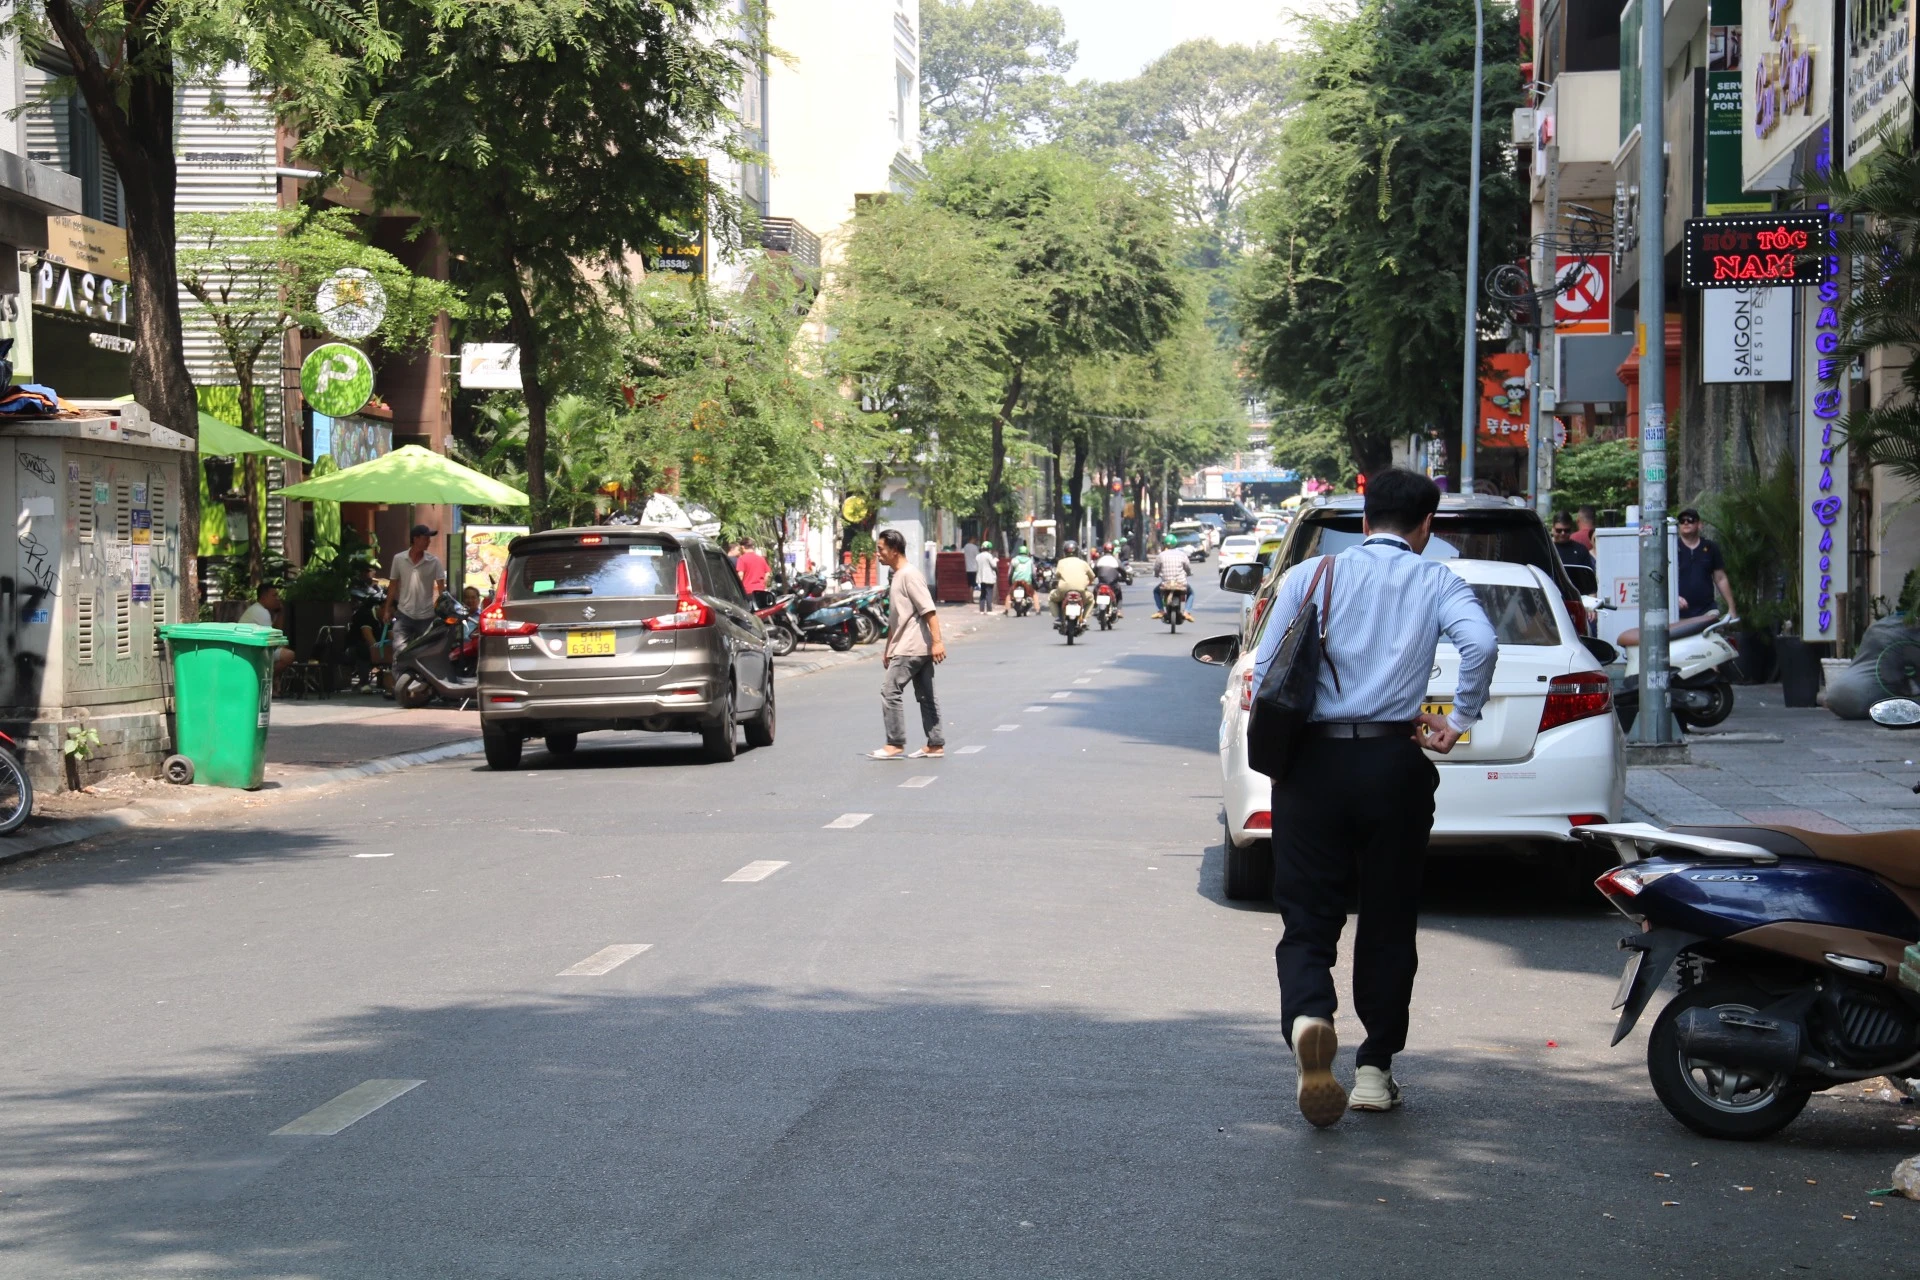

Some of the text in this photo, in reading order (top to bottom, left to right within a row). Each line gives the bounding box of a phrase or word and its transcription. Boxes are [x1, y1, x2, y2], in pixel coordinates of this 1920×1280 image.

[1713, 102, 1735, 111] FOR
[1703, 226, 1808, 250] HỚT TÓC
[654, 259, 692, 270] assag
[1713, 254, 1795, 279] NAM
[1734, 300, 1750, 376] SAIGON
[1811, 495, 1842, 634] Cherry
[1690, 874, 1759, 883] LEAD
